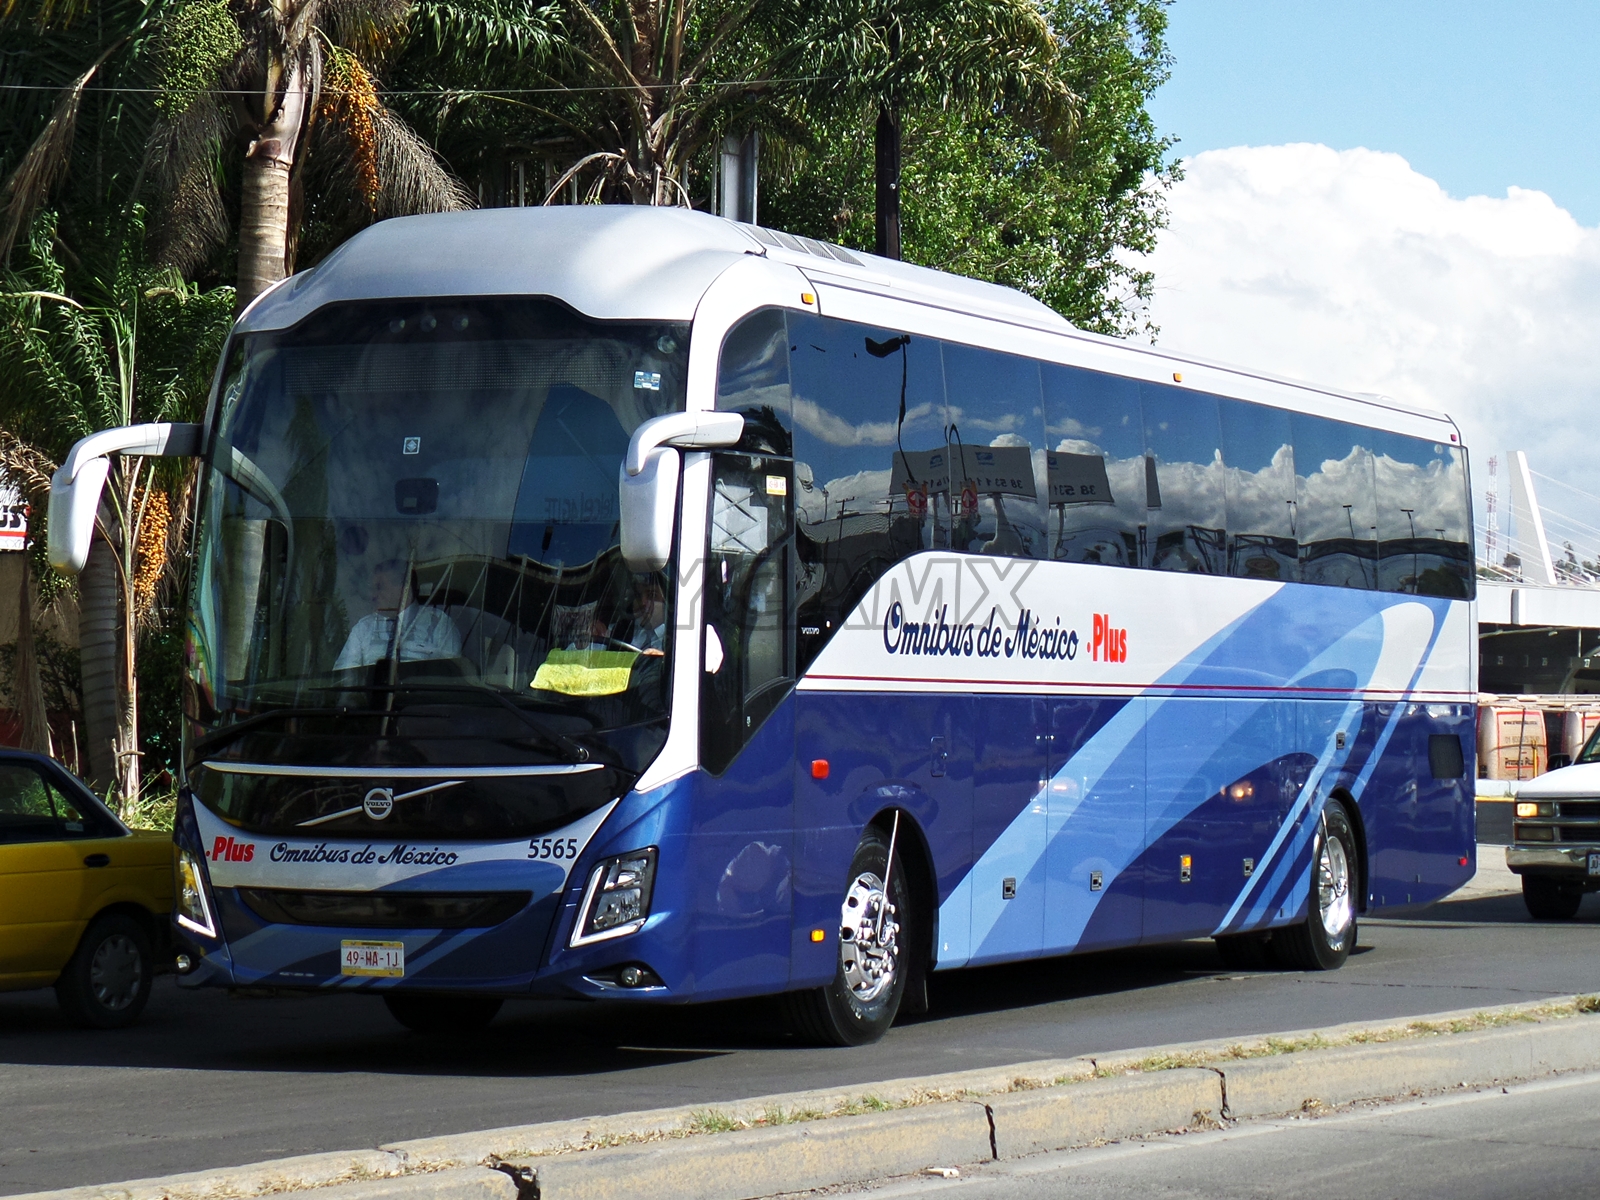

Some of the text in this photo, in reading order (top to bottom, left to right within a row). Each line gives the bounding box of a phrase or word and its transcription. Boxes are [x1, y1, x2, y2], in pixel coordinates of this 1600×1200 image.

[800, 626, 820, 635] VOLVO
[883, 600, 1080, 662] Omnibus de México
[269, 842, 459, 866] Omnibus de México
[527, 838, 578, 859] 5565
